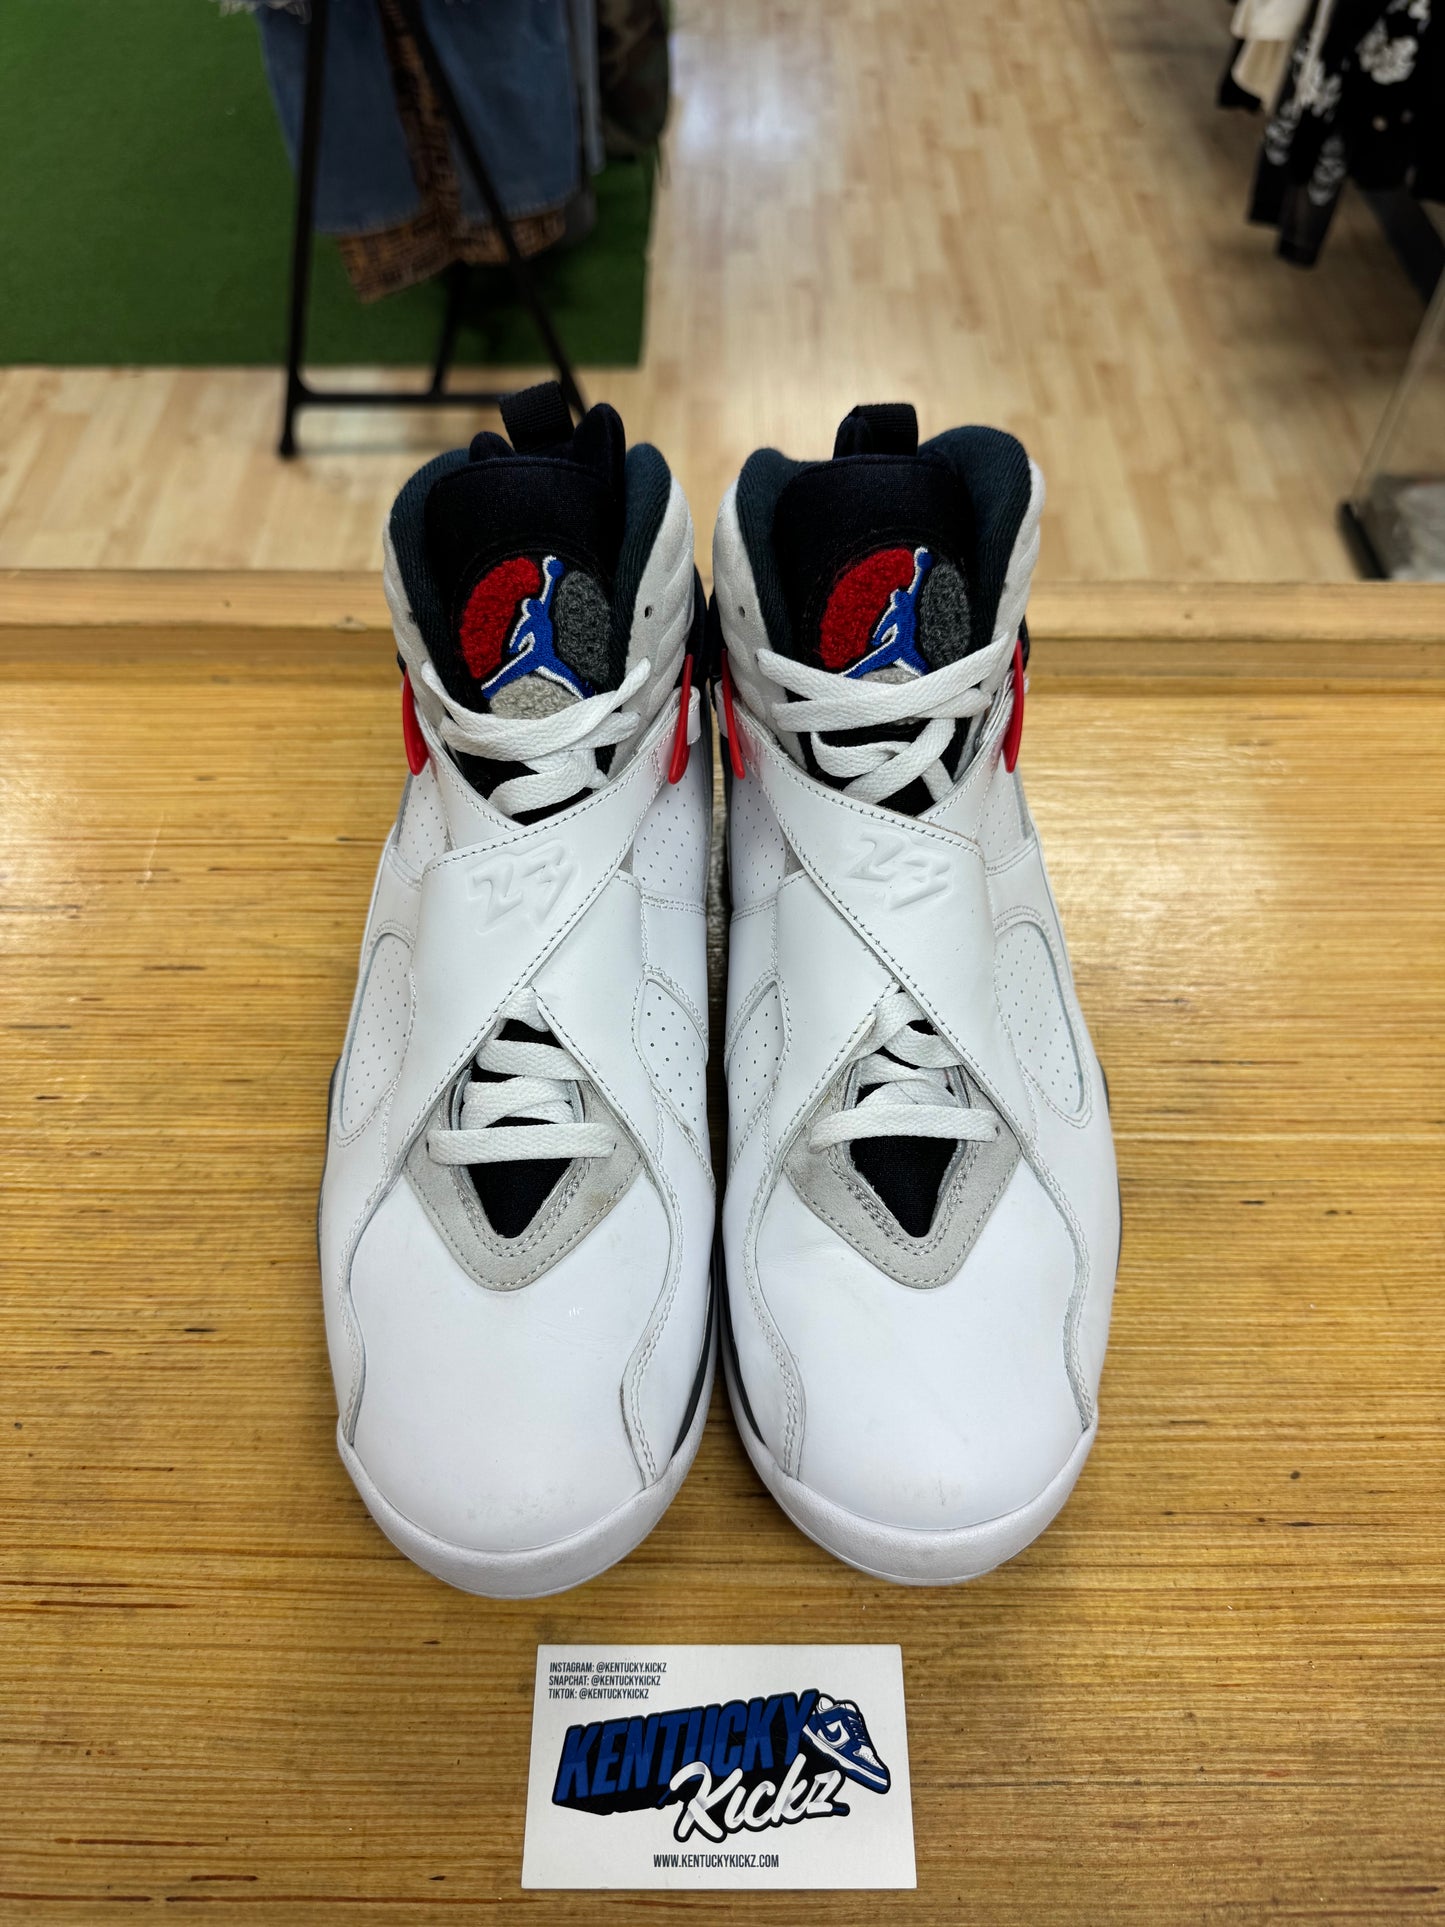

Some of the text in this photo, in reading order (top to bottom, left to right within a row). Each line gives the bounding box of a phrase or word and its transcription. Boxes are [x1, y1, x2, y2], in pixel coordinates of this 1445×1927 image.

[549, 1661, 667, 1673] INSTAGRAM: @KENTUCKY.KICKZ
[548, 1675, 661, 1686] SNAPCHAT: @KENTUCKYKICKZ
[548, 1688, 649, 1700] TIKTOK: @KENTUCKYKICKZ
[555, 1689, 820, 1803] KENTUCKY
[669, 1752, 842, 1840] Kickz
[653, 1854, 779, 1868] WWW.KENTUCKYKICKZ.COM
